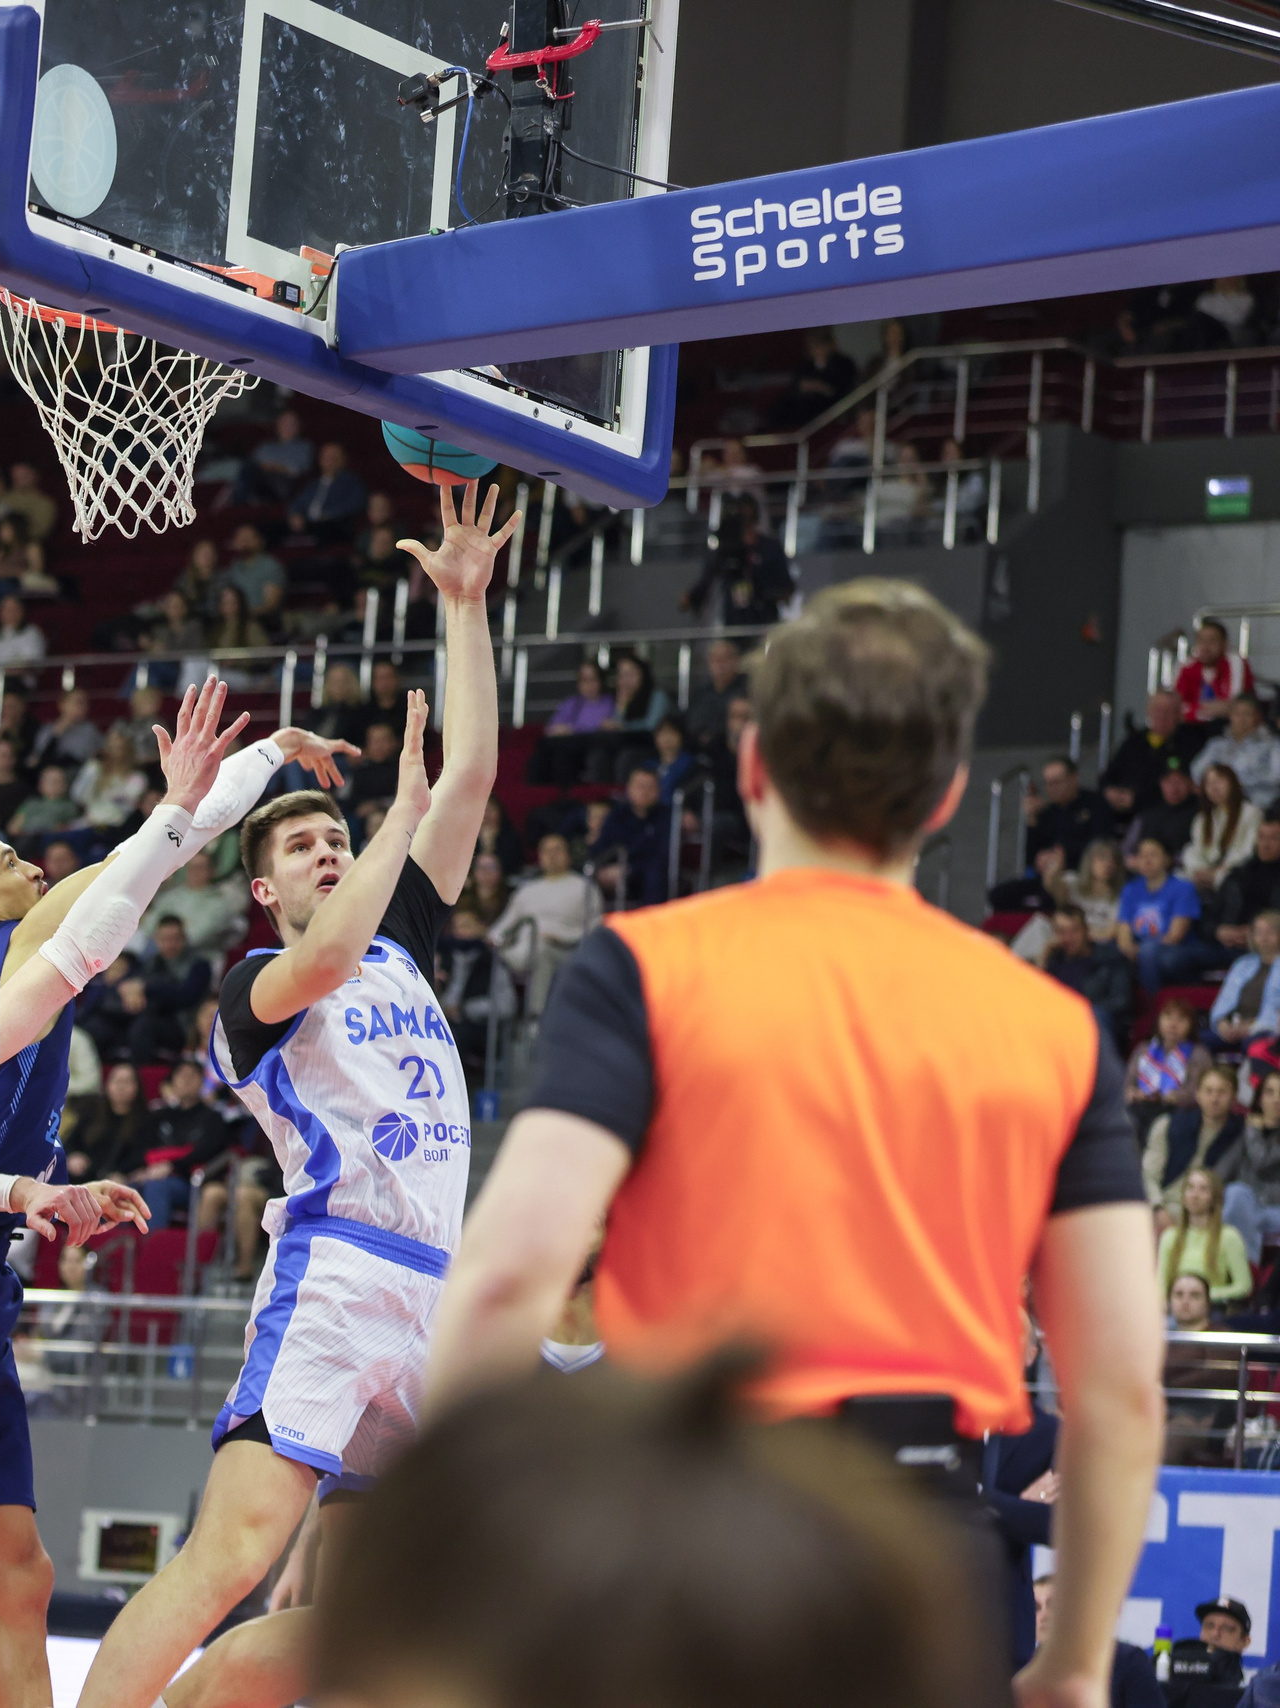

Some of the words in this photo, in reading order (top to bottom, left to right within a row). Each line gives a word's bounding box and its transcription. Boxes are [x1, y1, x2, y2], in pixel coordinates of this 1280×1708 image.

[691, 183, 902, 243] Schelde
[692, 223, 904, 286] Sports
[273, 1424, 305, 1441] ZEDO
